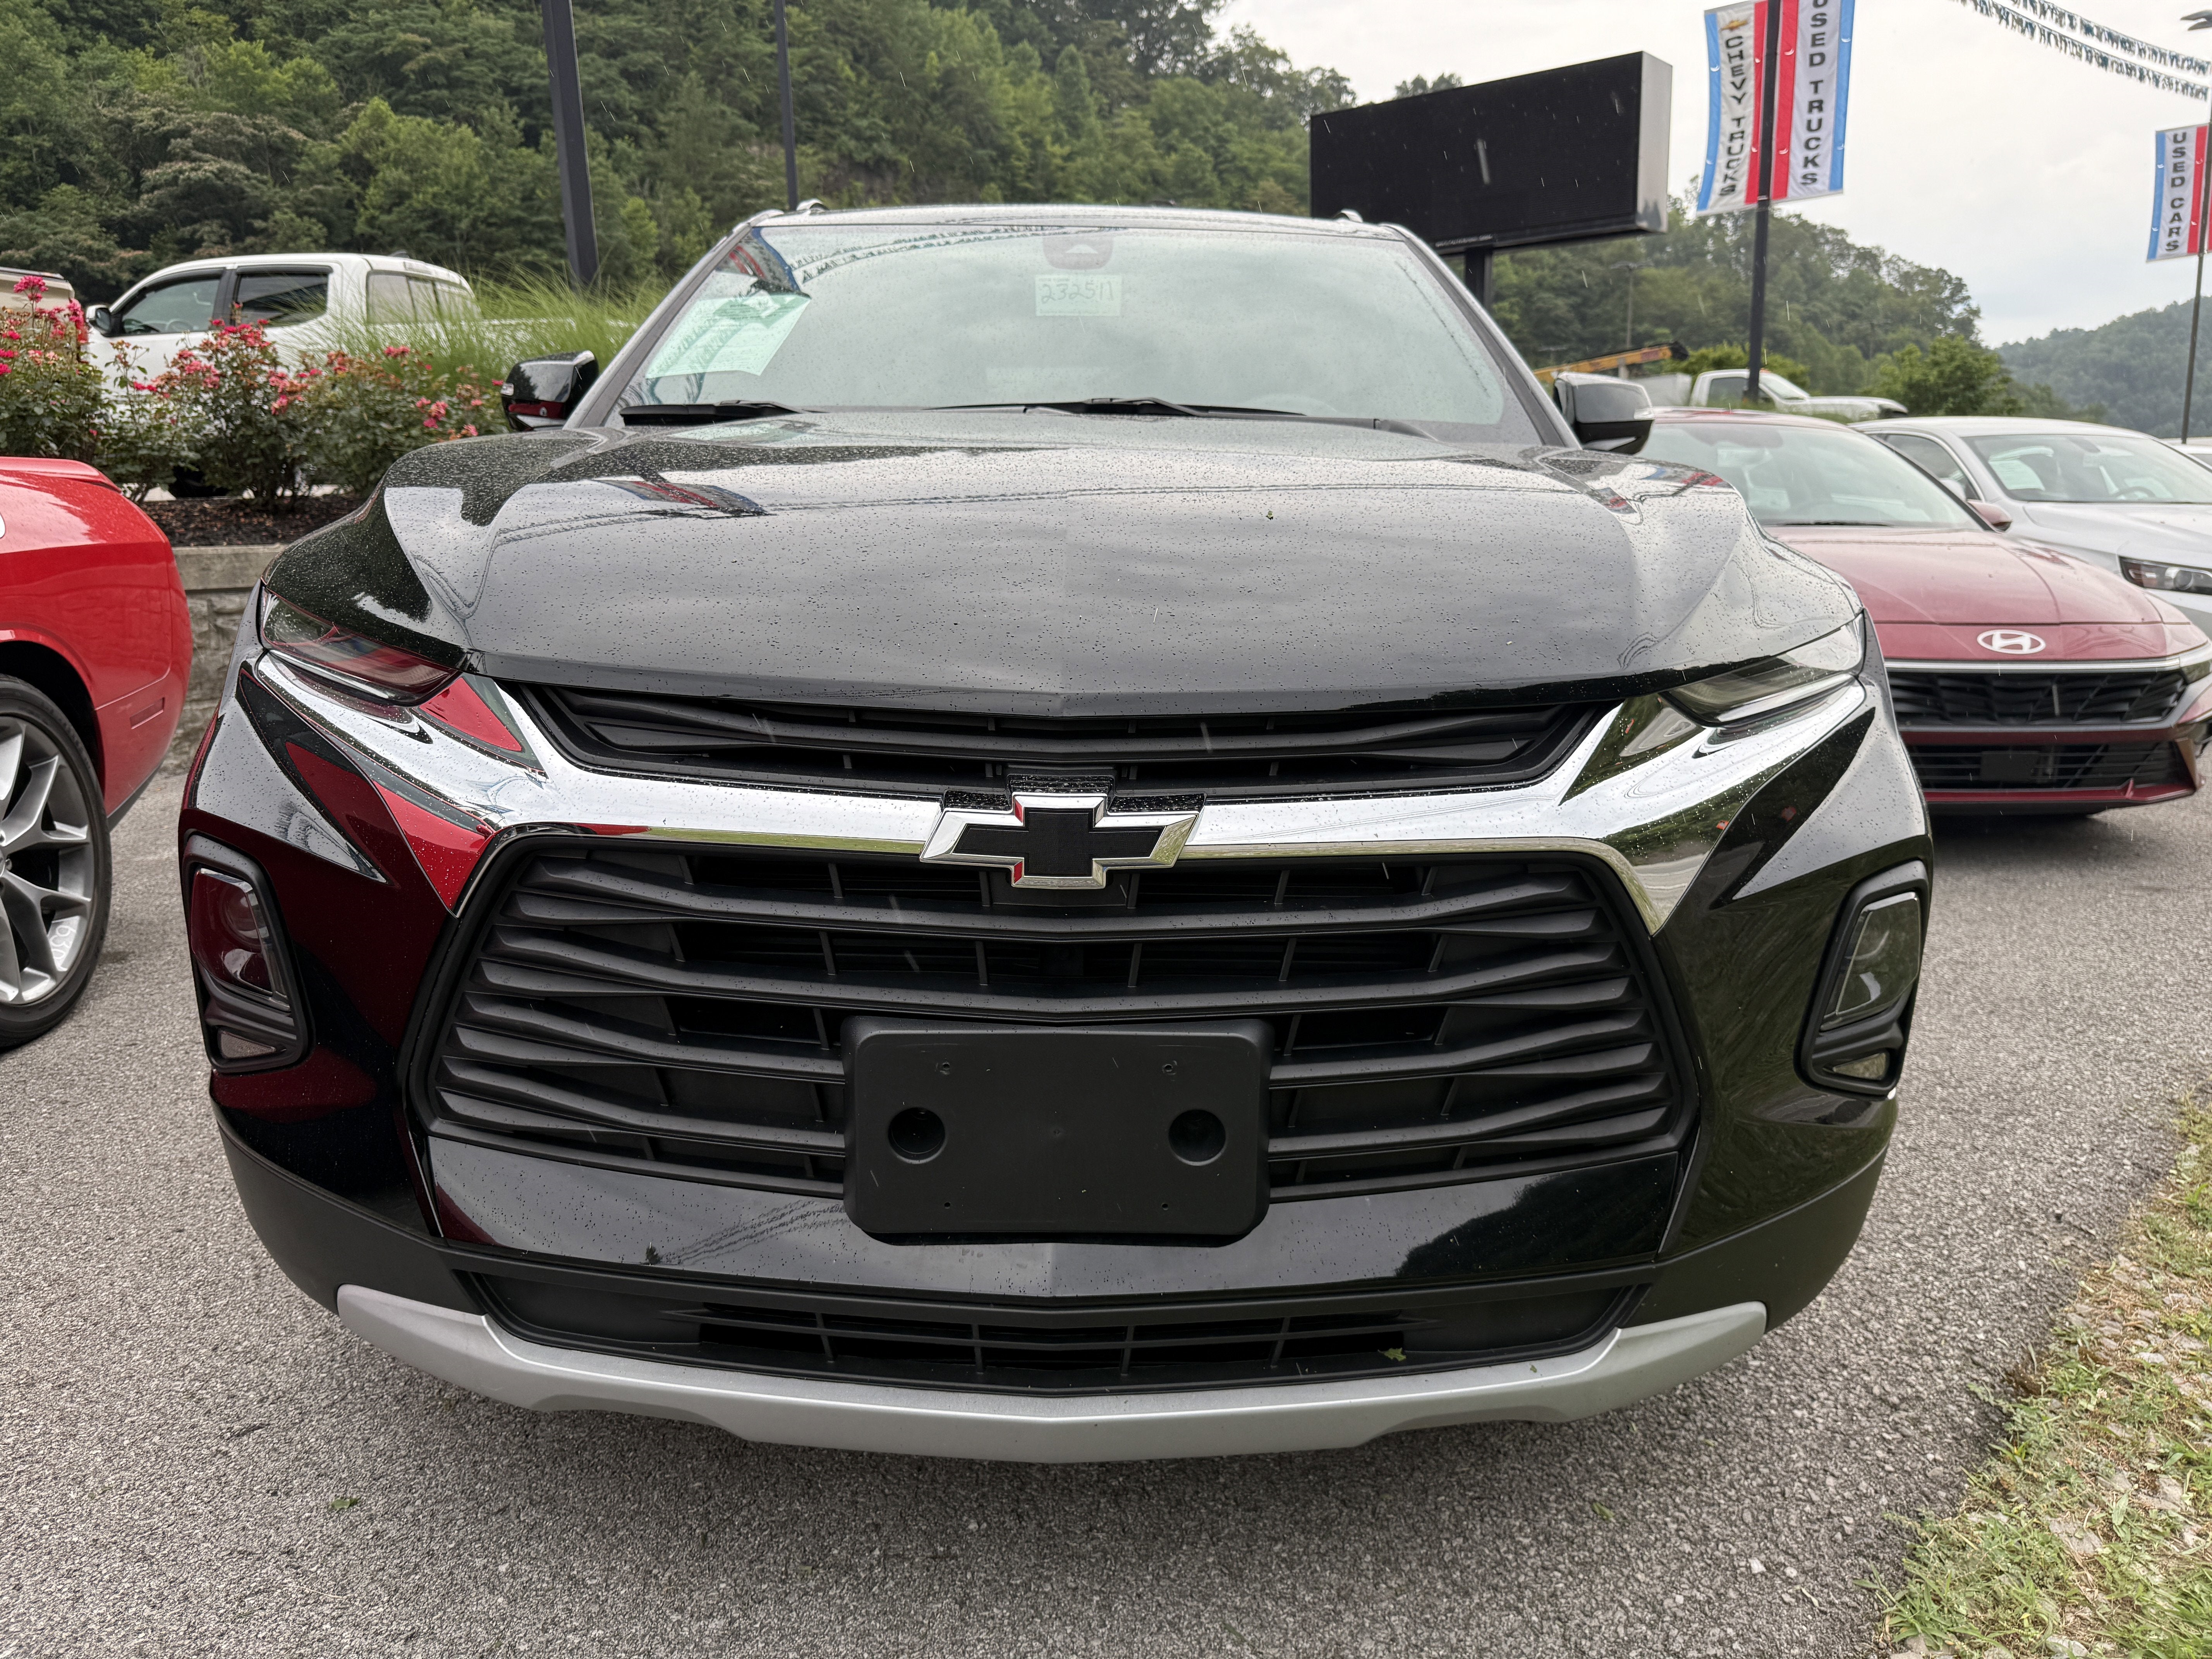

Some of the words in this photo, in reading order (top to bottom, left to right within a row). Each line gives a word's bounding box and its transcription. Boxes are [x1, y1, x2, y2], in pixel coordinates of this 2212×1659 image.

[1725, 36, 1745, 104] CHEVY
[1720, 116, 1745, 196] TRUCKS
[1801, 80, 1824, 186] TRUCKS
[2171, 132, 2187, 188] USED
[2166, 198, 2185, 251] CARS
